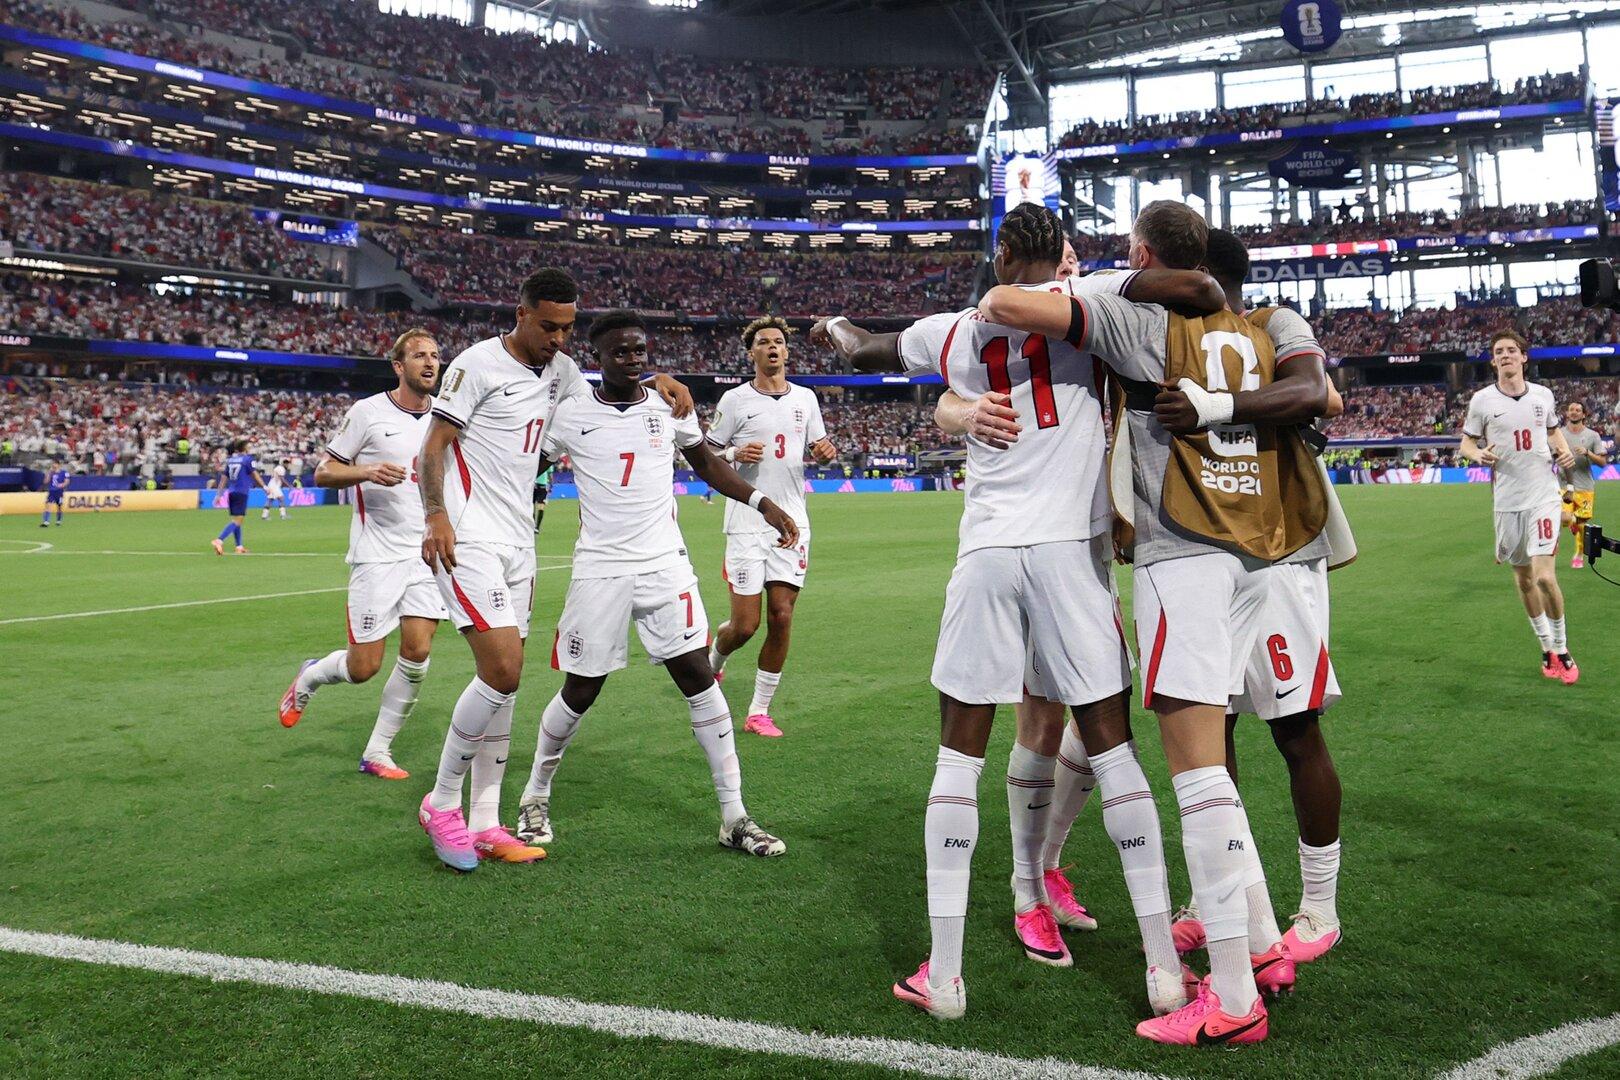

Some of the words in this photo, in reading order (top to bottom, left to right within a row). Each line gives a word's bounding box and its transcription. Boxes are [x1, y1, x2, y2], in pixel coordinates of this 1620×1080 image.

[375, 108, 416, 124] DALLAS
[1240, 129, 1282, 142] DALLAS
[535, 135, 556, 148] FIFA
[556, 139, 592, 152] WORLD
[592, 143, 612, 154] CUP
[612, 145, 647, 157] 2026
[1064, 147, 1083, 159] CUP
[769, 155, 810, 165] DALLAS
[1303, 151, 1324, 160] FIFA
[432, 157, 476, 170] DALLAS
[1286, 160, 1323, 170] WORLD
[1323, 158, 1345, 168] CUP
[254, 167, 277, 180] FIFA
[277, 170, 312, 186] WORLD
[312, 176, 331, 188] CUP
[1298, 168, 1333, 177] 2026
[598, 178, 614, 186] FIFA
[615, 179, 642, 188] WORLD
[642, 181, 657, 189] CUP
[657, 183, 684, 191] 2026
[806, 188, 853, 197] DALLAS
[283, 220, 326, 235] DALLAS
[1416, 236, 1456, 248] DALLAS
[1251, 258, 1384, 282] DALLAS
[0, 335, 31, 346] LLAS
[1388, 354, 1420, 364] DALLAS
[980, 332, 1060, 437] 11
[523, 418, 544, 454] 17
[1220, 430, 1254, 445] FIFA
[1513, 429, 1533, 451] 18
[775, 433, 785, 459] 3
[619, 452, 634, 487] 7
[1200, 456, 1248, 473] WORLD
[1466, 467, 1491, 482] Thi
[891, 478, 915, 492] This
[68, 495, 121, 508] DALLAS
[1537, 518, 1553, 540] 18
[679, 591, 693, 628] 7
[1266, 633, 1294, 682] 6
[944, 837, 971, 849] ENG
[1121, 836, 1146, 850] ENG
[1227, 839, 1245, 851] EN
